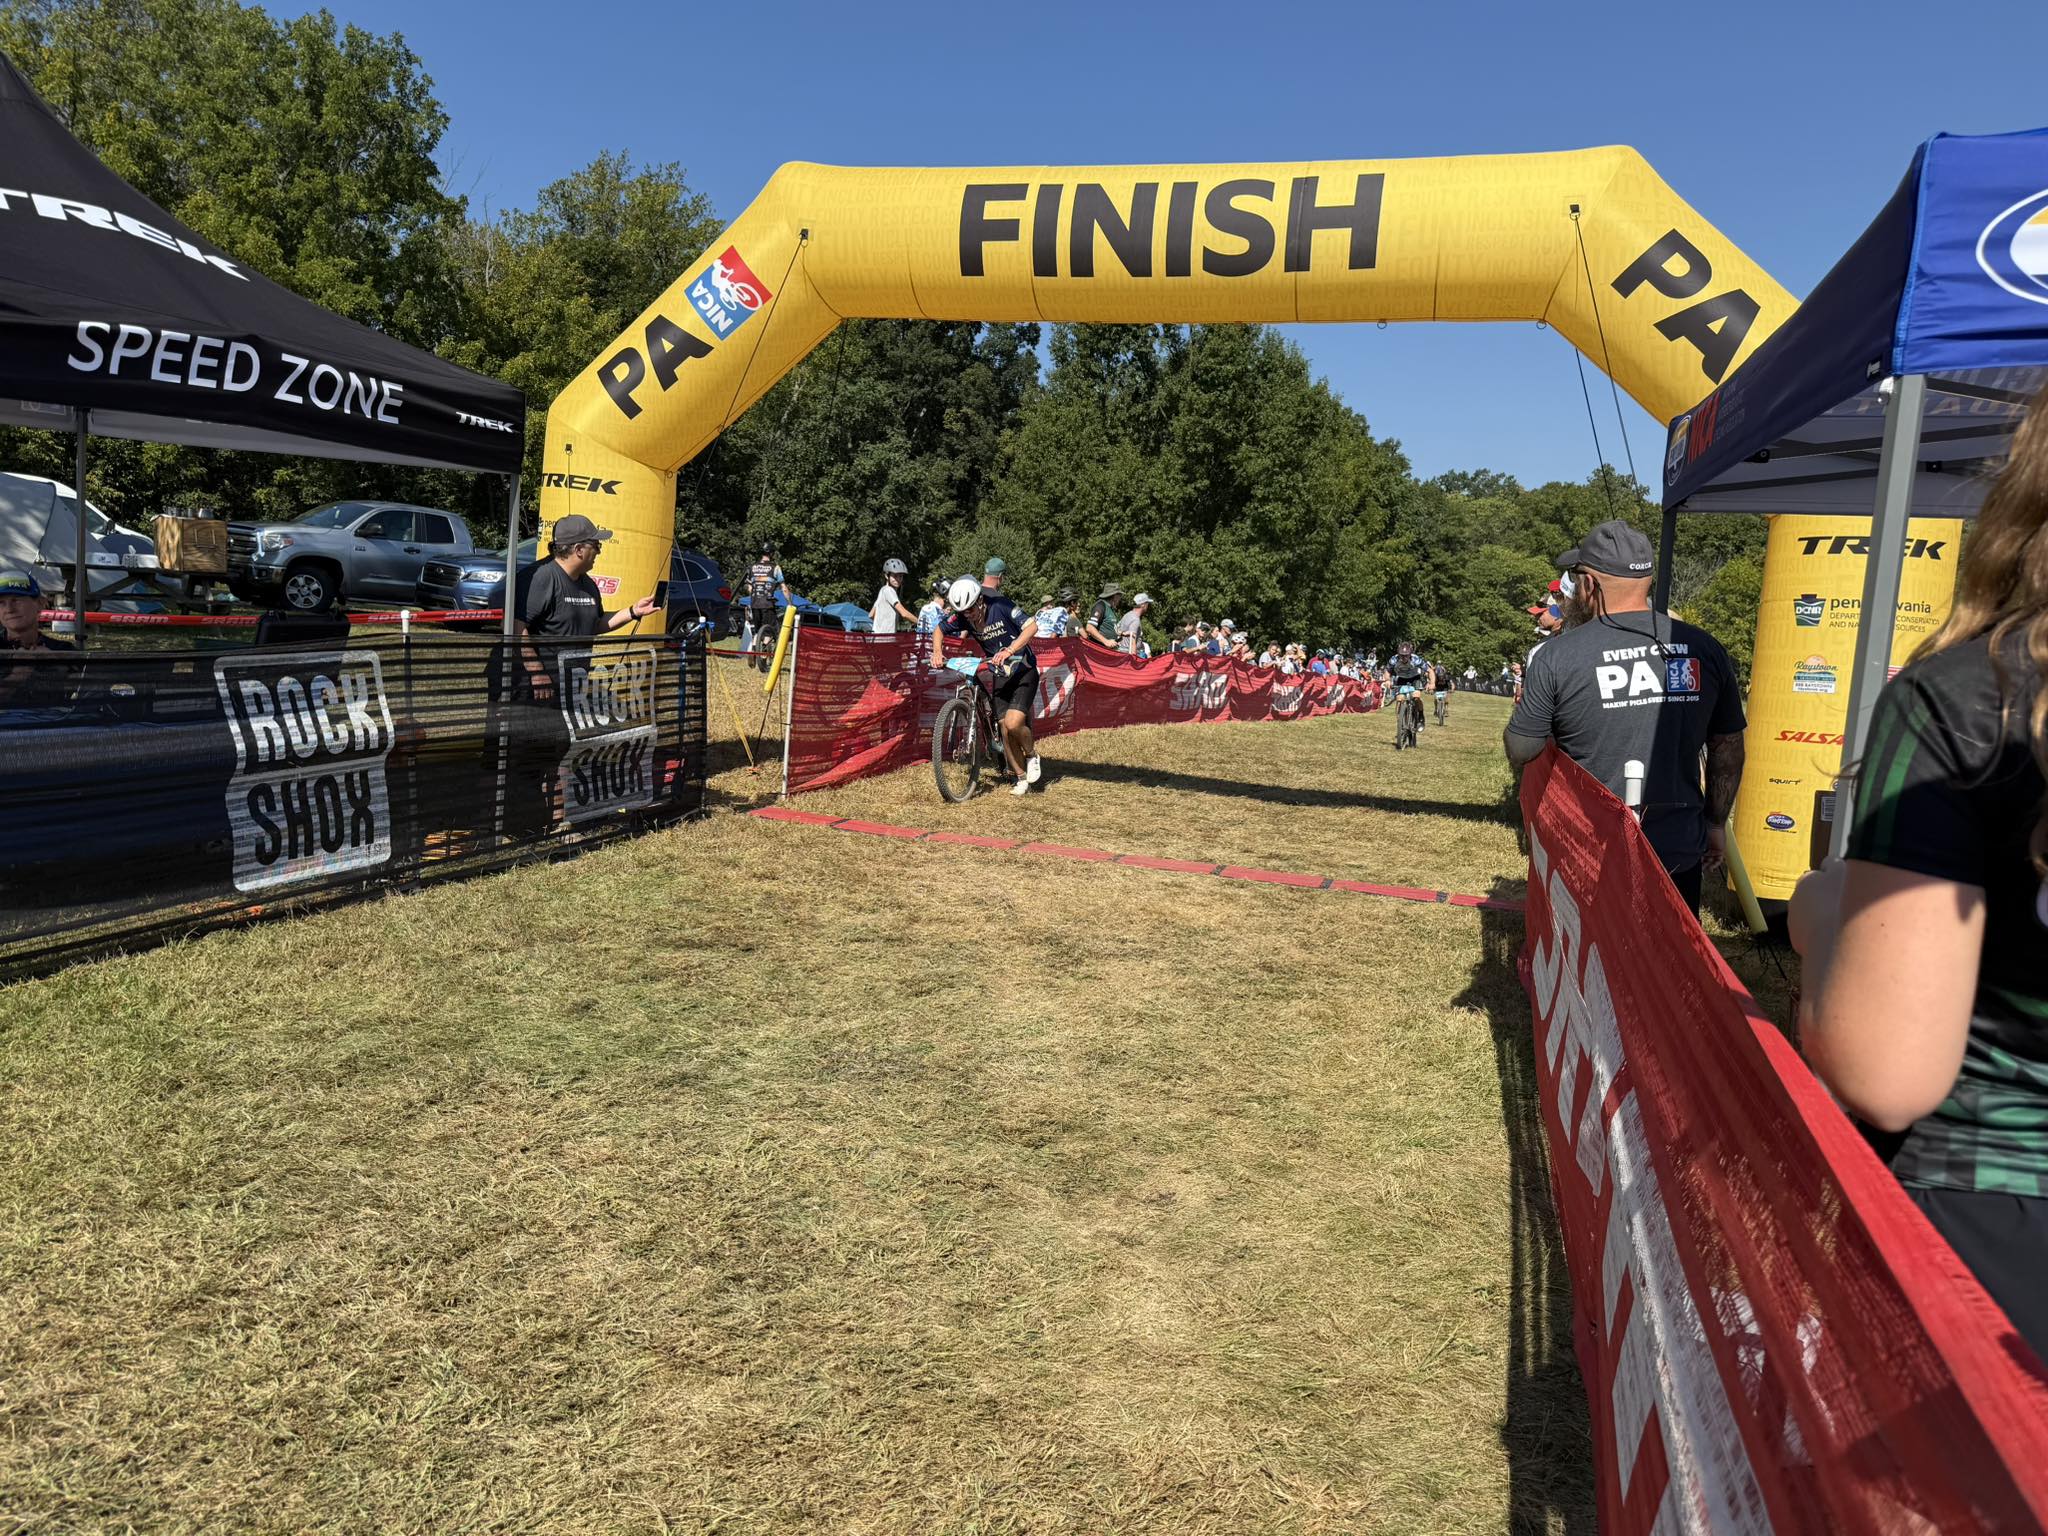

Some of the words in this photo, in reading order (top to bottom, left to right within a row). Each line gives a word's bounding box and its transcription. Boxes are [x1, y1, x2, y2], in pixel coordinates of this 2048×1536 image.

[959, 172, 1386, 278] FINISH
[690, 279, 733, 333] NICA
[1611, 227, 1762, 386] PA
[67, 320, 261, 393] SPEED
[273, 352, 405, 425] ZONE
[596, 313, 715, 421] PA
[455, 410, 516, 433] TREK
[109, 613, 170, 624] SRAM
[1828, 620, 1846, 628] AND
[1830, 597, 1932, 614] penvania
[1895, 625, 1927, 633] SOURCES
[1602, 645, 1648, 662] EVENT
[1650, 643, 1689, 656] CEW
[1670, 660, 1680, 689] NICA
[570, 661, 648, 730] ROCK
[1595, 660, 1664, 700] PA
[239, 673, 380, 763] ROCK
[571, 735, 650, 807] SHOX
[246, 770, 375, 866] SHOX
